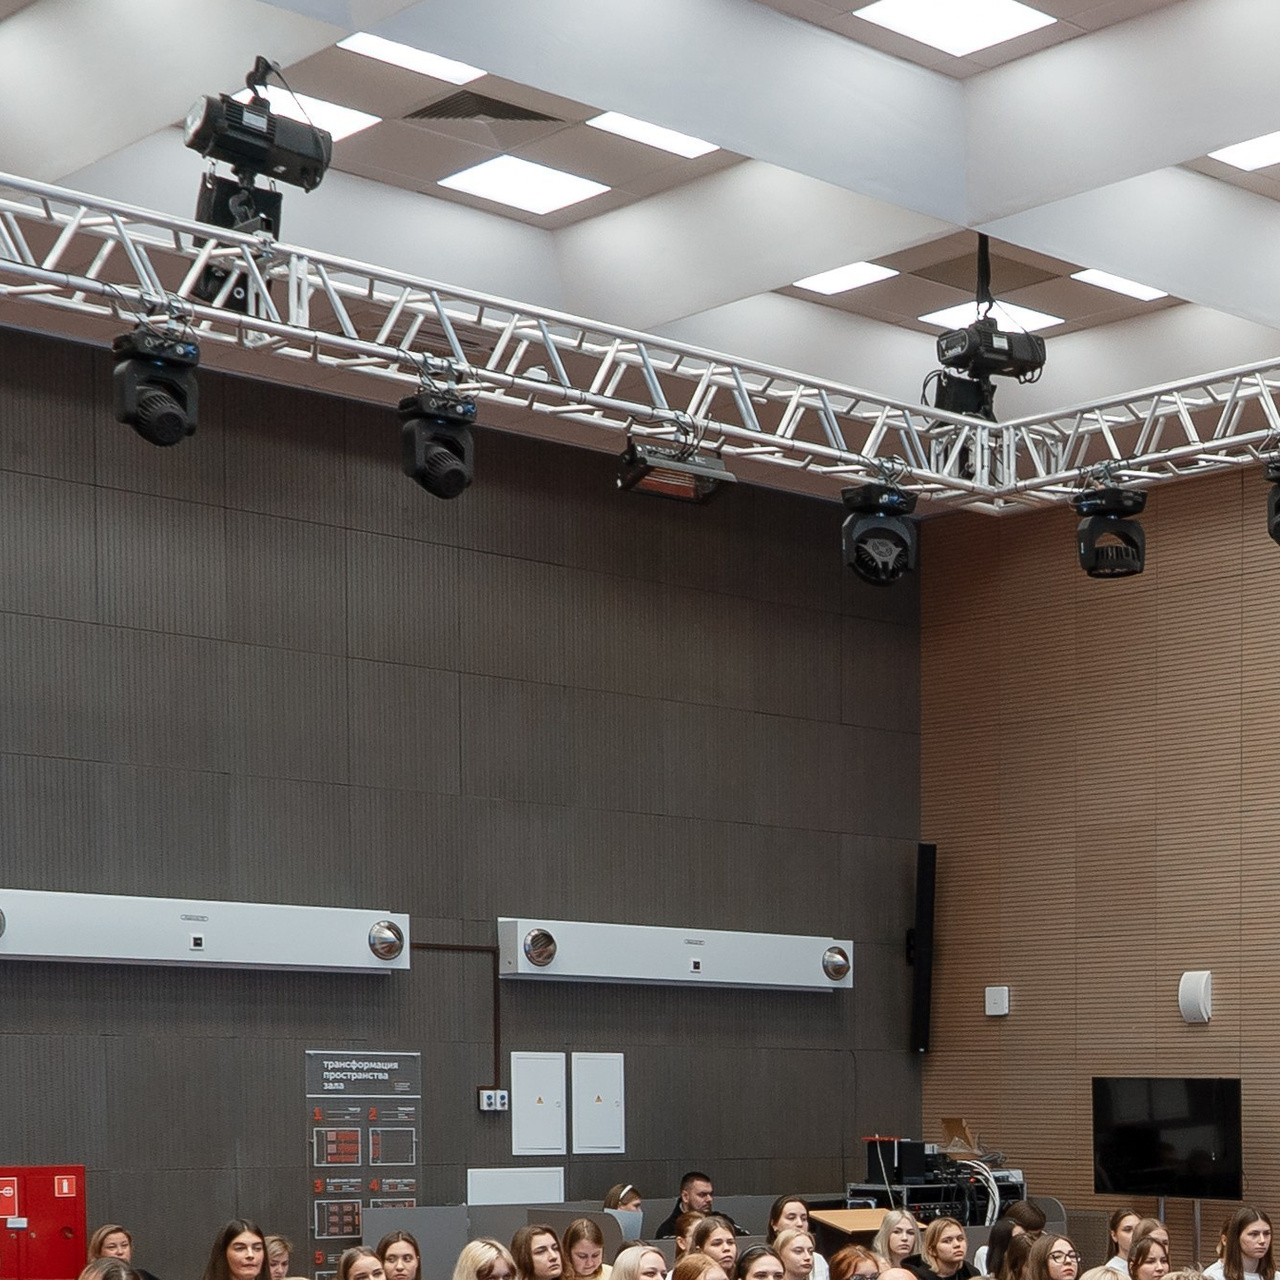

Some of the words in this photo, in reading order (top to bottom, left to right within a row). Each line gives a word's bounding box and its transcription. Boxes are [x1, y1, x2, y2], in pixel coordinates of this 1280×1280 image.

[323, 1060, 398, 1070] трансформация
[323, 1071, 388, 1080] пространства
[323, 1082, 344, 1090] зала
[313, 1106, 322, 1120] 1
[368, 1106, 377, 1120] 2
[314, 1178, 322, 1193] 3
[369, 1179, 379, 1191] 4
[314, 1251, 324, 1264] 5
